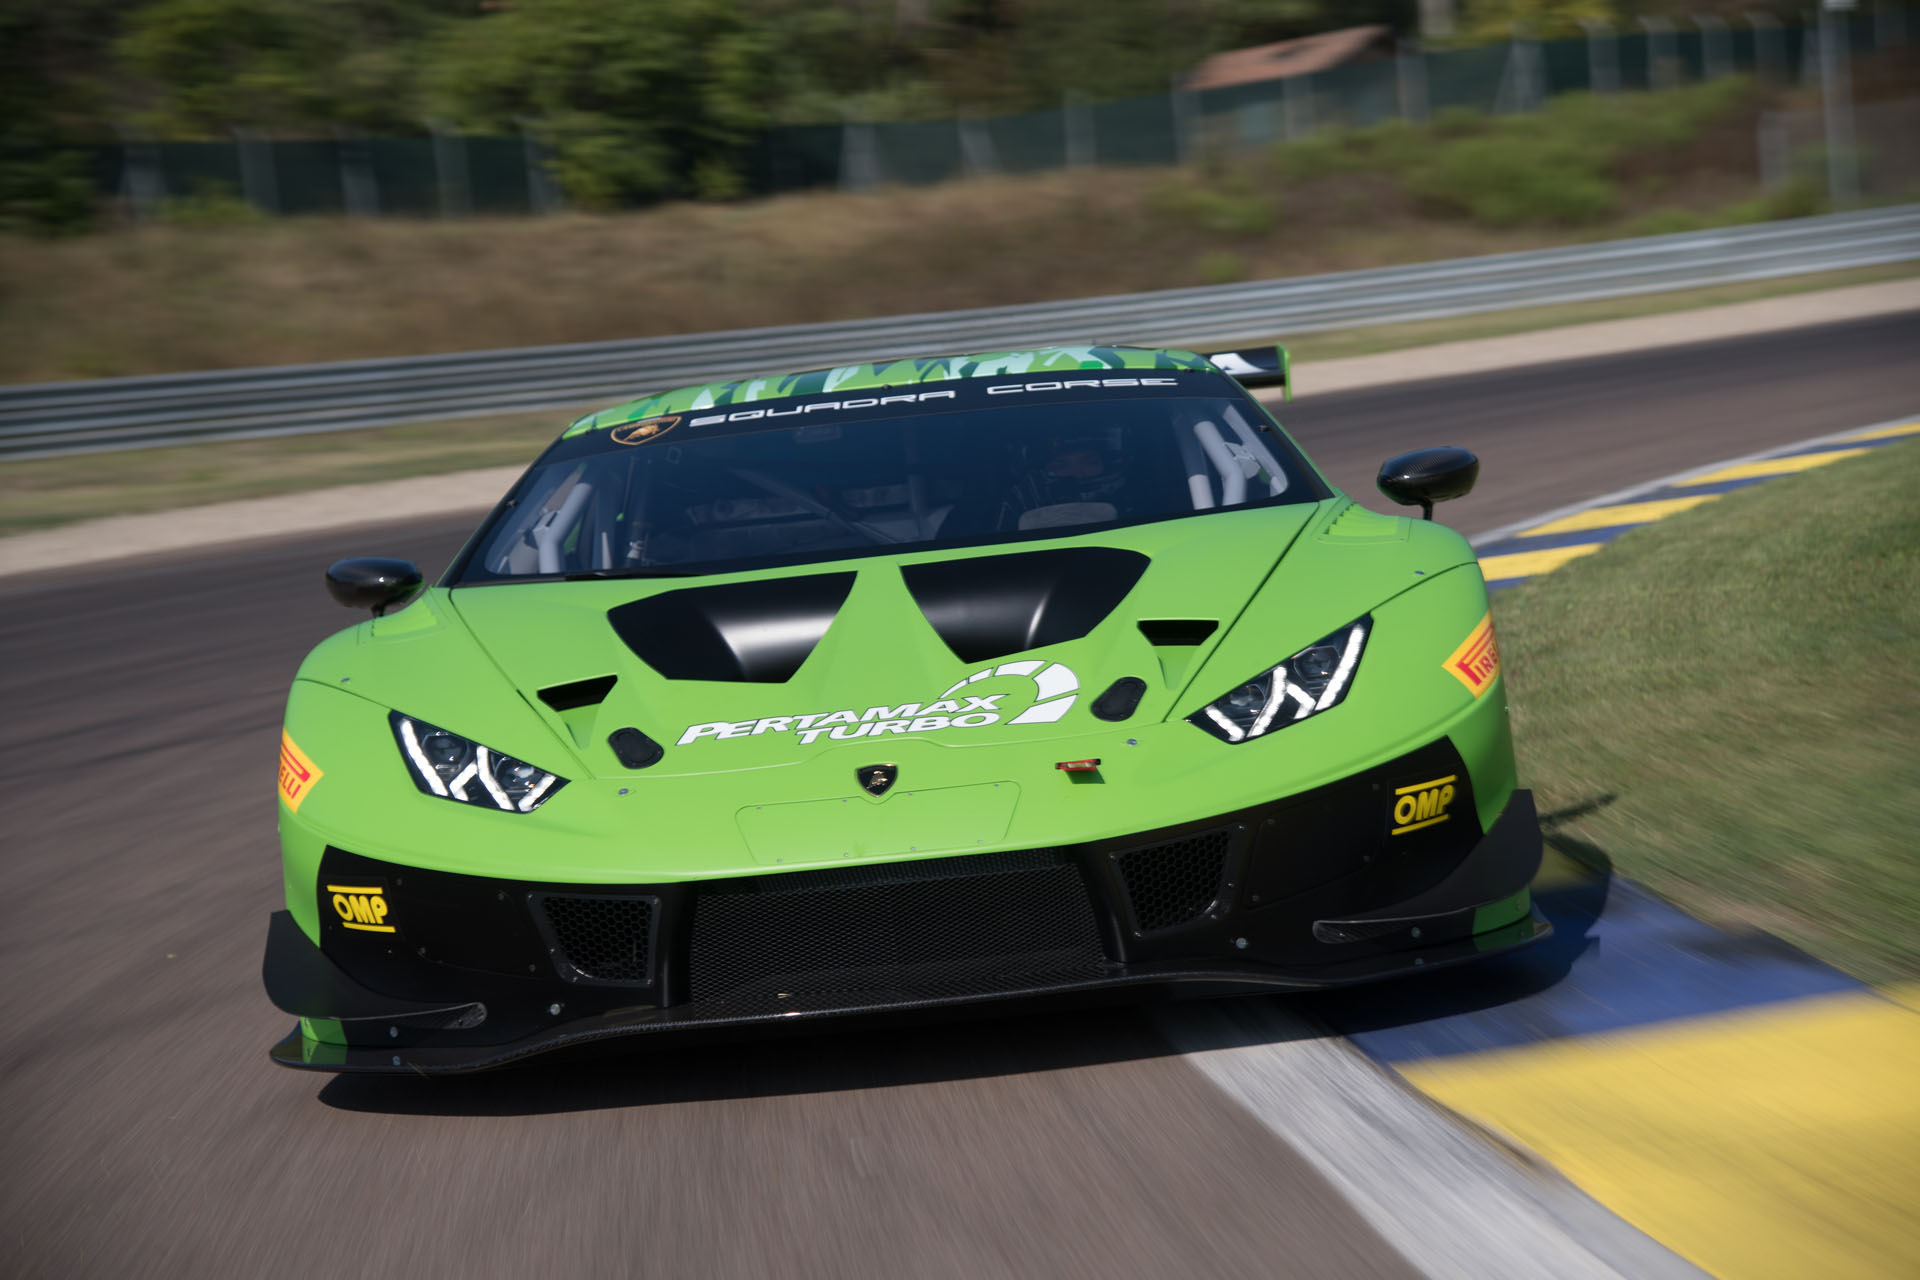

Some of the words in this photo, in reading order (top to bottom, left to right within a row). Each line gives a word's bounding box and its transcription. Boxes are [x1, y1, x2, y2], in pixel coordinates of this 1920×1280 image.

[690, 391, 955, 427] SQUADRA
[987, 378, 1179, 395] CORSE
[675, 694, 1010, 746] PERTAMAX
[798, 713, 1001, 745] TURBO
[1394, 786, 1455, 825] OMP
[332, 894, 388, 924] OMP
